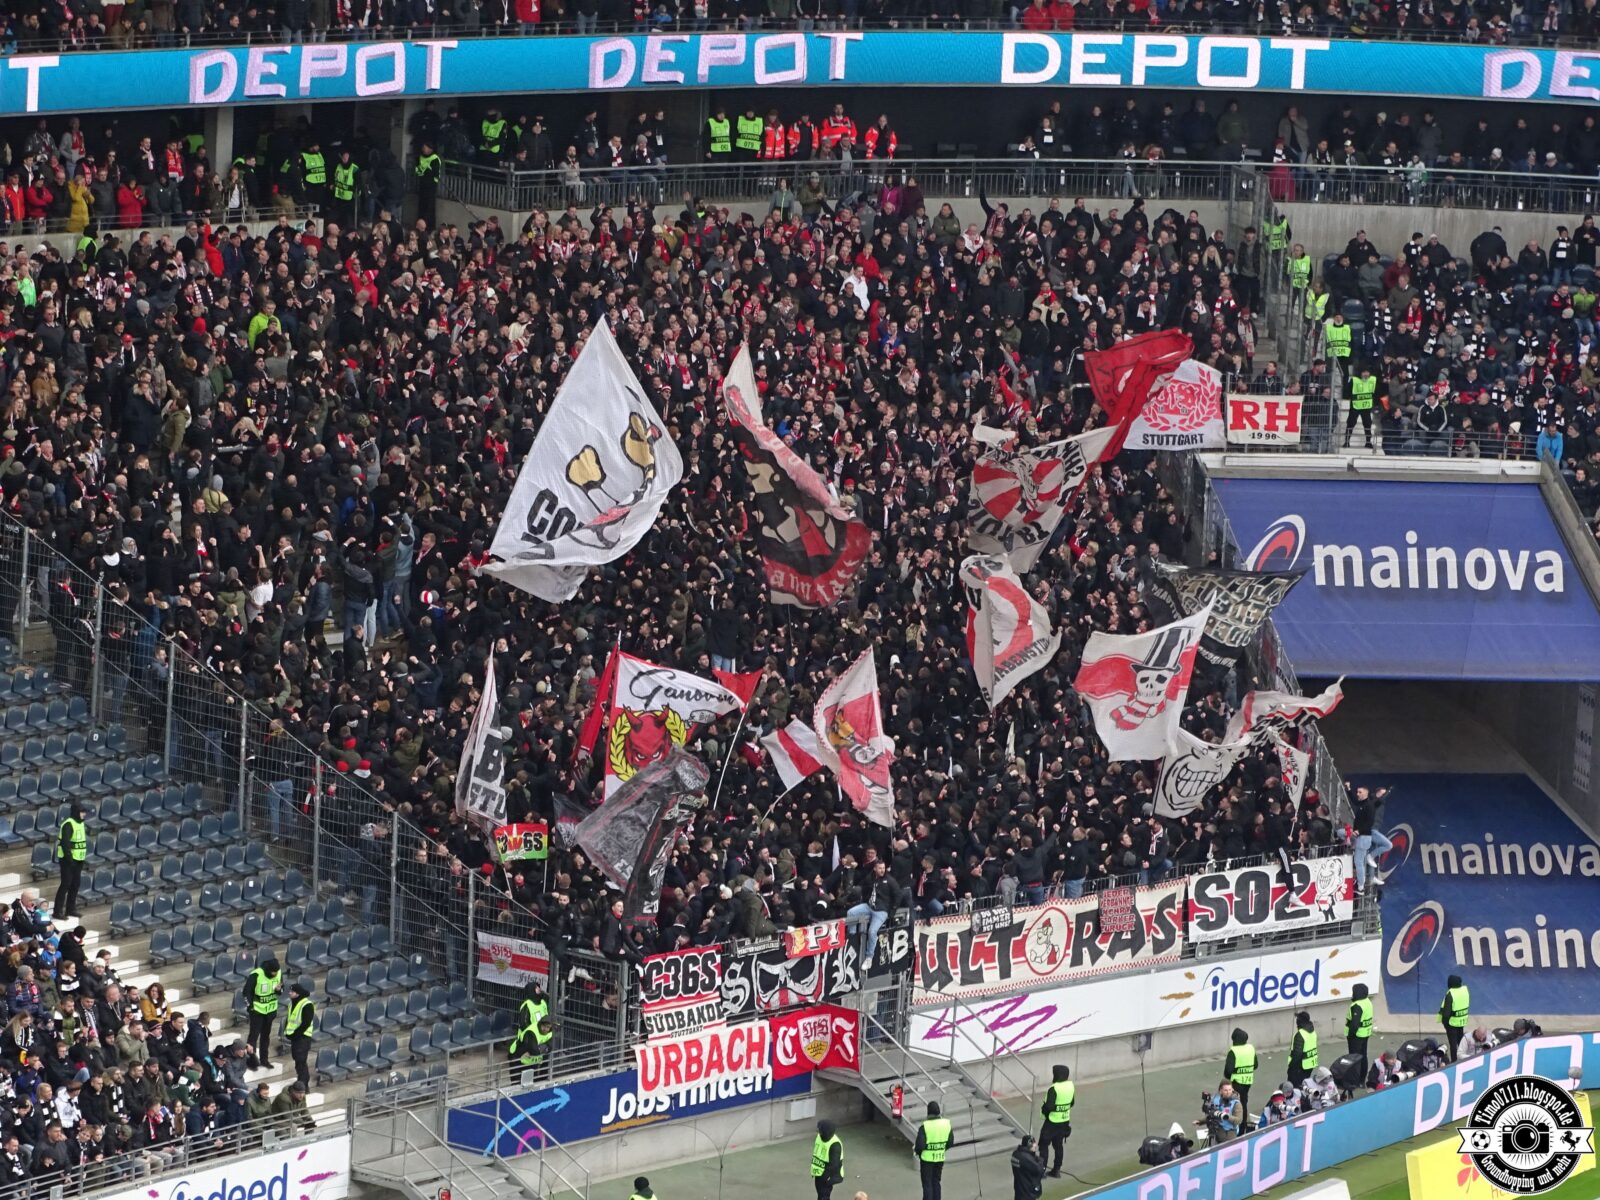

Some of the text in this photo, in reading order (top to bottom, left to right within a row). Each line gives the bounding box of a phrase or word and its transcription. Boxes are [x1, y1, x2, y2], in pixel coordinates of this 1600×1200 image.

[189, 40, 458, 104] DEPOT
[589, 32, 864, 89] DEPOT
[1001, 33, 1330, 90] DEPOT
[1142, 433, 1204, 446] STUTTGART
[1229, 400, 1300, 433] RH
[1313, 531, 1565, 593] mainova
[1420, 832, 1600, 877] mainova
[1452, 913, 1600, 969] main
[1211, 958, 1320, 1012] indeed
[640, 1027, 767, 1092] URBACH
[1138, 1111, 1325, 1200] DEPOT
